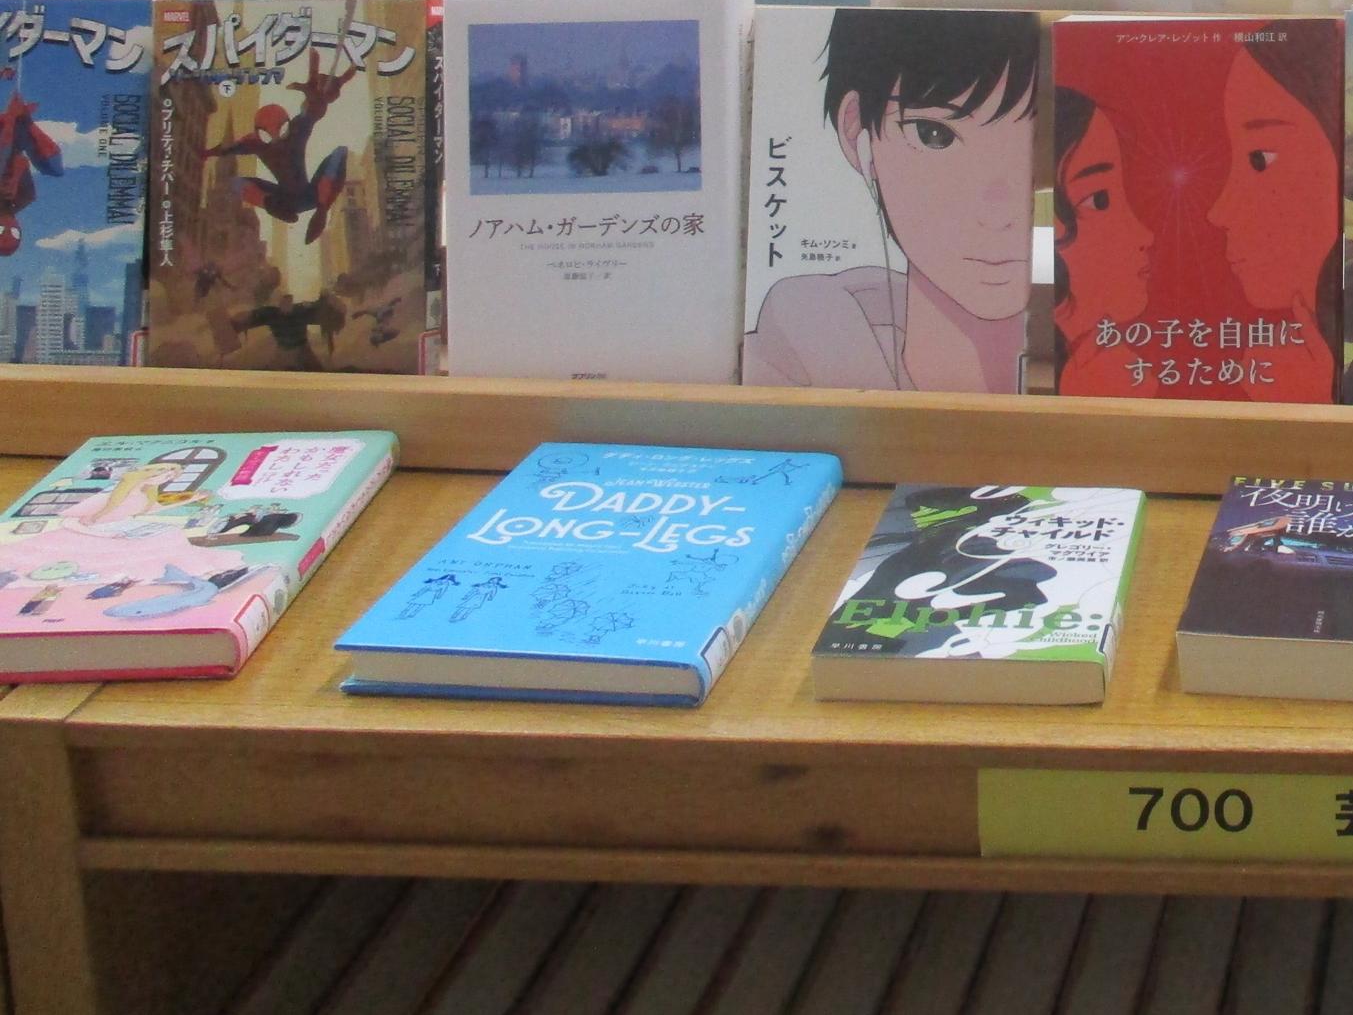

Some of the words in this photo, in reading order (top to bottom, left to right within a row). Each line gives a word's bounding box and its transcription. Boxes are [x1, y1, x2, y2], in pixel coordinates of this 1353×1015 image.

[160, 4, 416, 86] スパイダーマン
[1116, 31, 1209, 44] アン・クレア・レゾット
[1211, 31, 1222, 44] 作
[1233, 30, 1276, 44] 横山和江
[763, 135, 789, 268] ビスケット
[468, 212, 705, 239] ノアハム・ガーデンズの家
[800, 237, 850, 251] キム・ソンミ
[1095, 318, 1305, 348] あの子を自由に
[1125, 357, 1275, 386] するために
[1233, 476, 1307, 489] FIVE
[538, 480, 747, 516] DADDY-
[466, 508, 756, 553] LONG-LEGS
[991, 526, 1115, 541] チャイルド
[834, 598, 1104, 634] Elphie:
[1127, 786, 1254, 833] 700
